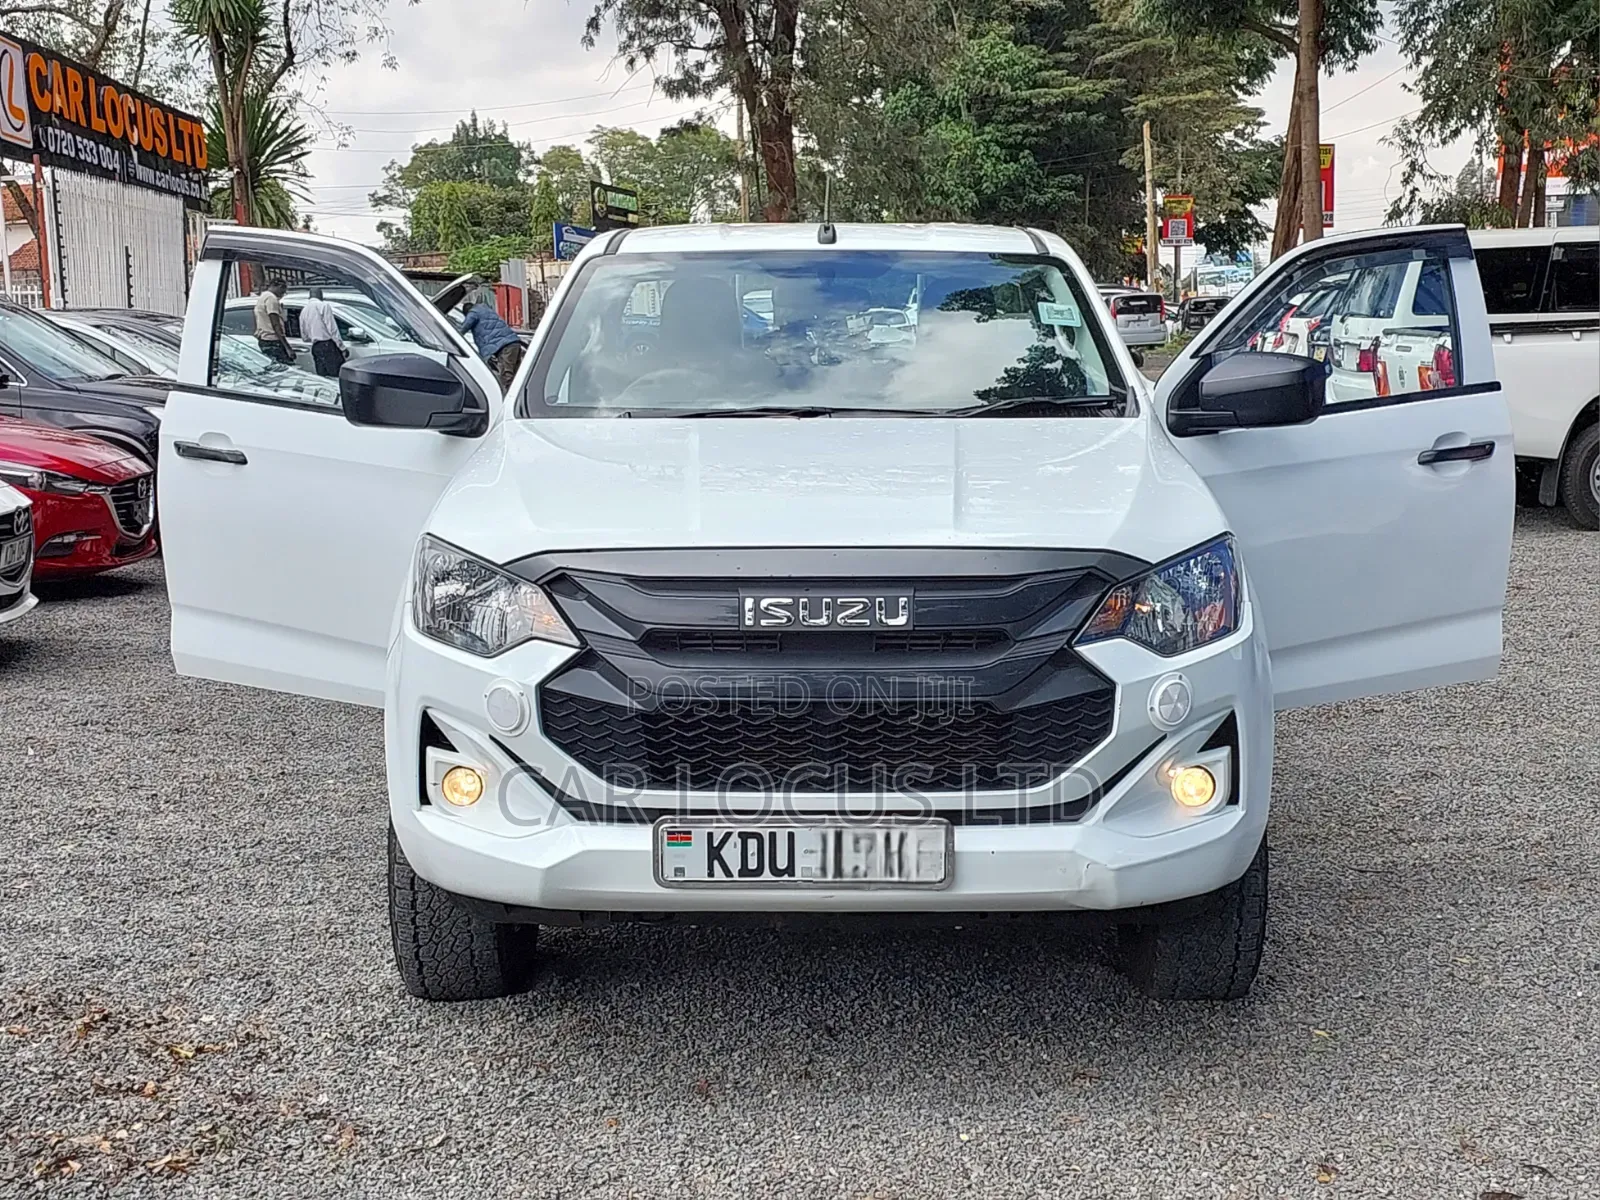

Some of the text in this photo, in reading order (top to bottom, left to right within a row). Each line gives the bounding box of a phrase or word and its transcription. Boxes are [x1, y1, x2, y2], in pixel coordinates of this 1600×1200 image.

[26, 52, 208, 169] CAR LOCUS LTD
[47, 126, 120, 174] 0720 533 004
[744, 596, 910, 627] ISUZU
[706, 830, 796, 879] KDU
